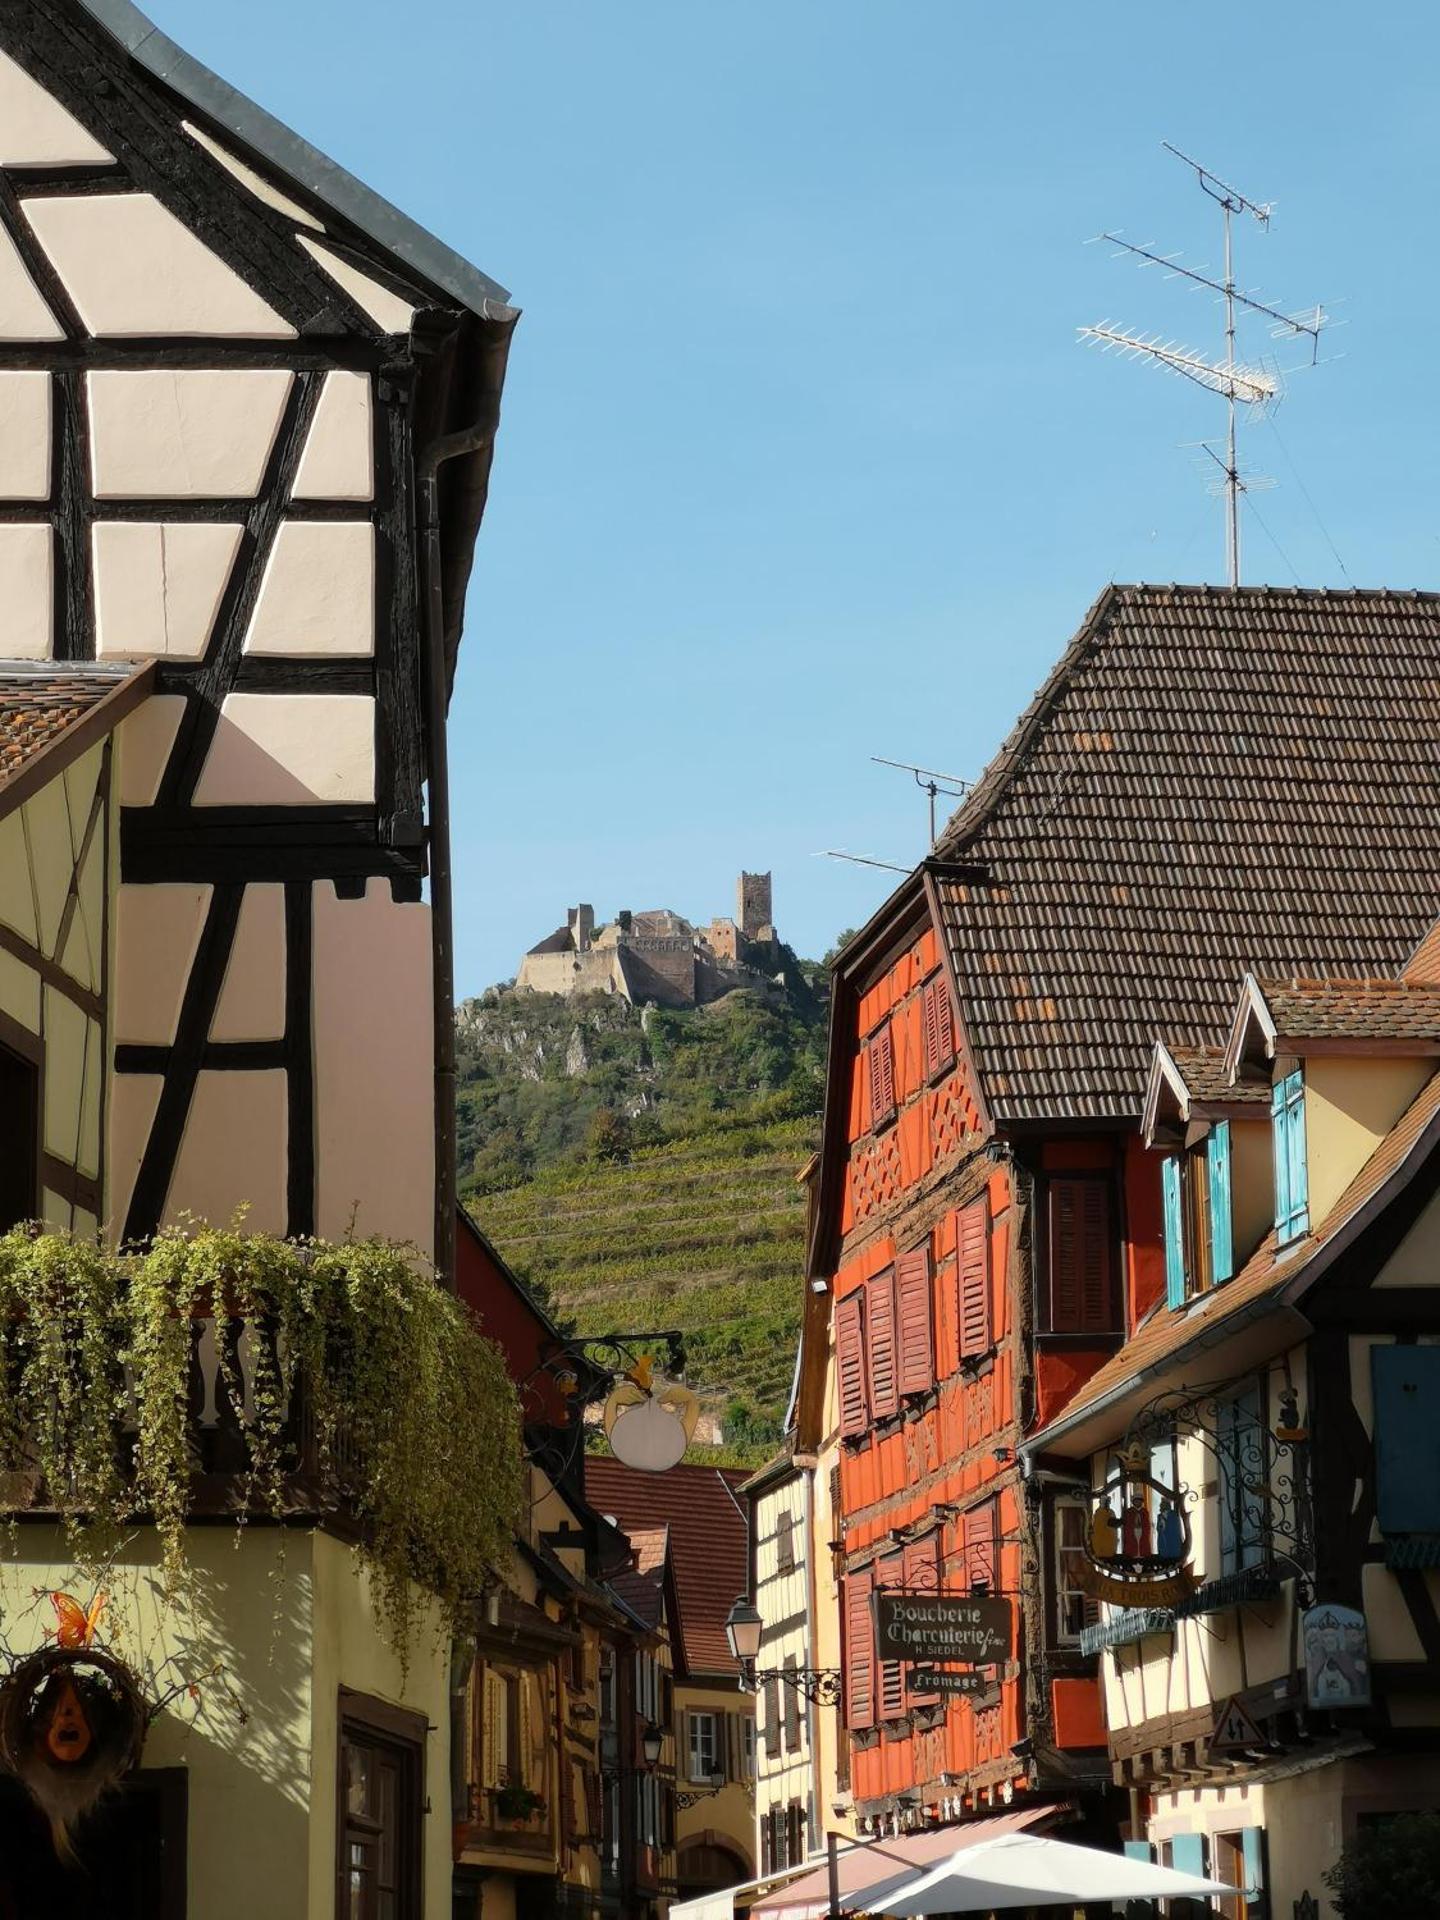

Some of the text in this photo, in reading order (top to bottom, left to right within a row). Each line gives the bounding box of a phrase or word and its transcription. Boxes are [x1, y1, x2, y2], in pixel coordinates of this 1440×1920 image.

[892, 1602, 982, 1623] Boucherie
[887, 1623, 985, 1644] Charcuterie
[927, 1646, 965, 1656] SIEDEL
